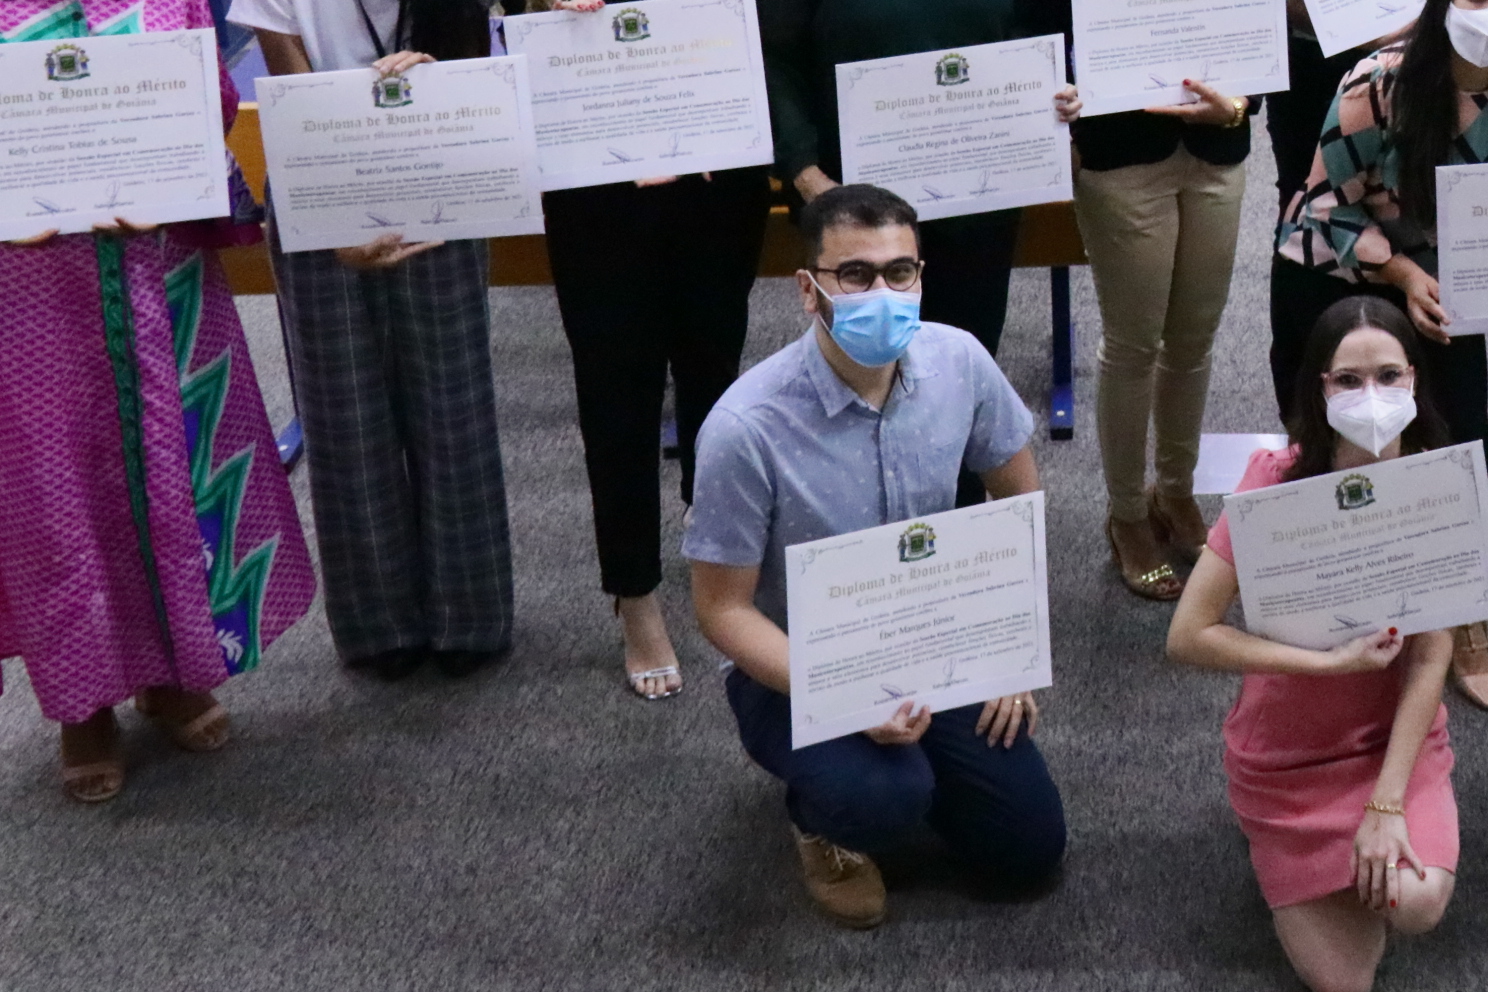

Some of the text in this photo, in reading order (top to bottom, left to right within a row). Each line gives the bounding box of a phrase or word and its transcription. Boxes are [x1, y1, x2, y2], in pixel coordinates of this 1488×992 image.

[1150, 27, 1178, 36] Fernanda
[547, 53, 602, 66] Diploma
[607, 50, 620, 59] de
[625, 46, 666, 57] Honra
[38, 90, 54, 100] de
[60, 87, 108, 99] Honra
[114, 85, 129, 94] ao
[874, 96, 924, 111] Diploma
[928, 94, 939, 102] de
[945, 89, 981, 100] Honra
[985, 87, 998, 95] ao
[302, 119, 361, 132] Diploma
[365, 116, 378, 126] de
[385, 113, 429, 124] Honra
[433, 112, 449, 120] ao
[8, 147, 27, 155] Kelly
[31, 144, 64, 153] Cristina
[97, 138, 107, 146] de
[898, 142, 923, 152] Claudia
[925, 140, 948, 148] Regina
[1271, 524, 1326, 543] Diploma
[1330, 520, 1343, 529] de
[1349, 509, 1390, 526] Honra
[1394, 504, 1410, 514] ao
[1316, 570, 1343, 579] Mayara
[1387, 552, 1413, 562] Ribeiro
[828, 578, 885, 598] Diploma
[890, 573, 902, 584] de
[909, 562, 949, 579] Honra
[954, 558, 968, 569] ao
[943, 578, 952, 586] de
[898, 621, 930, 633] Marques
